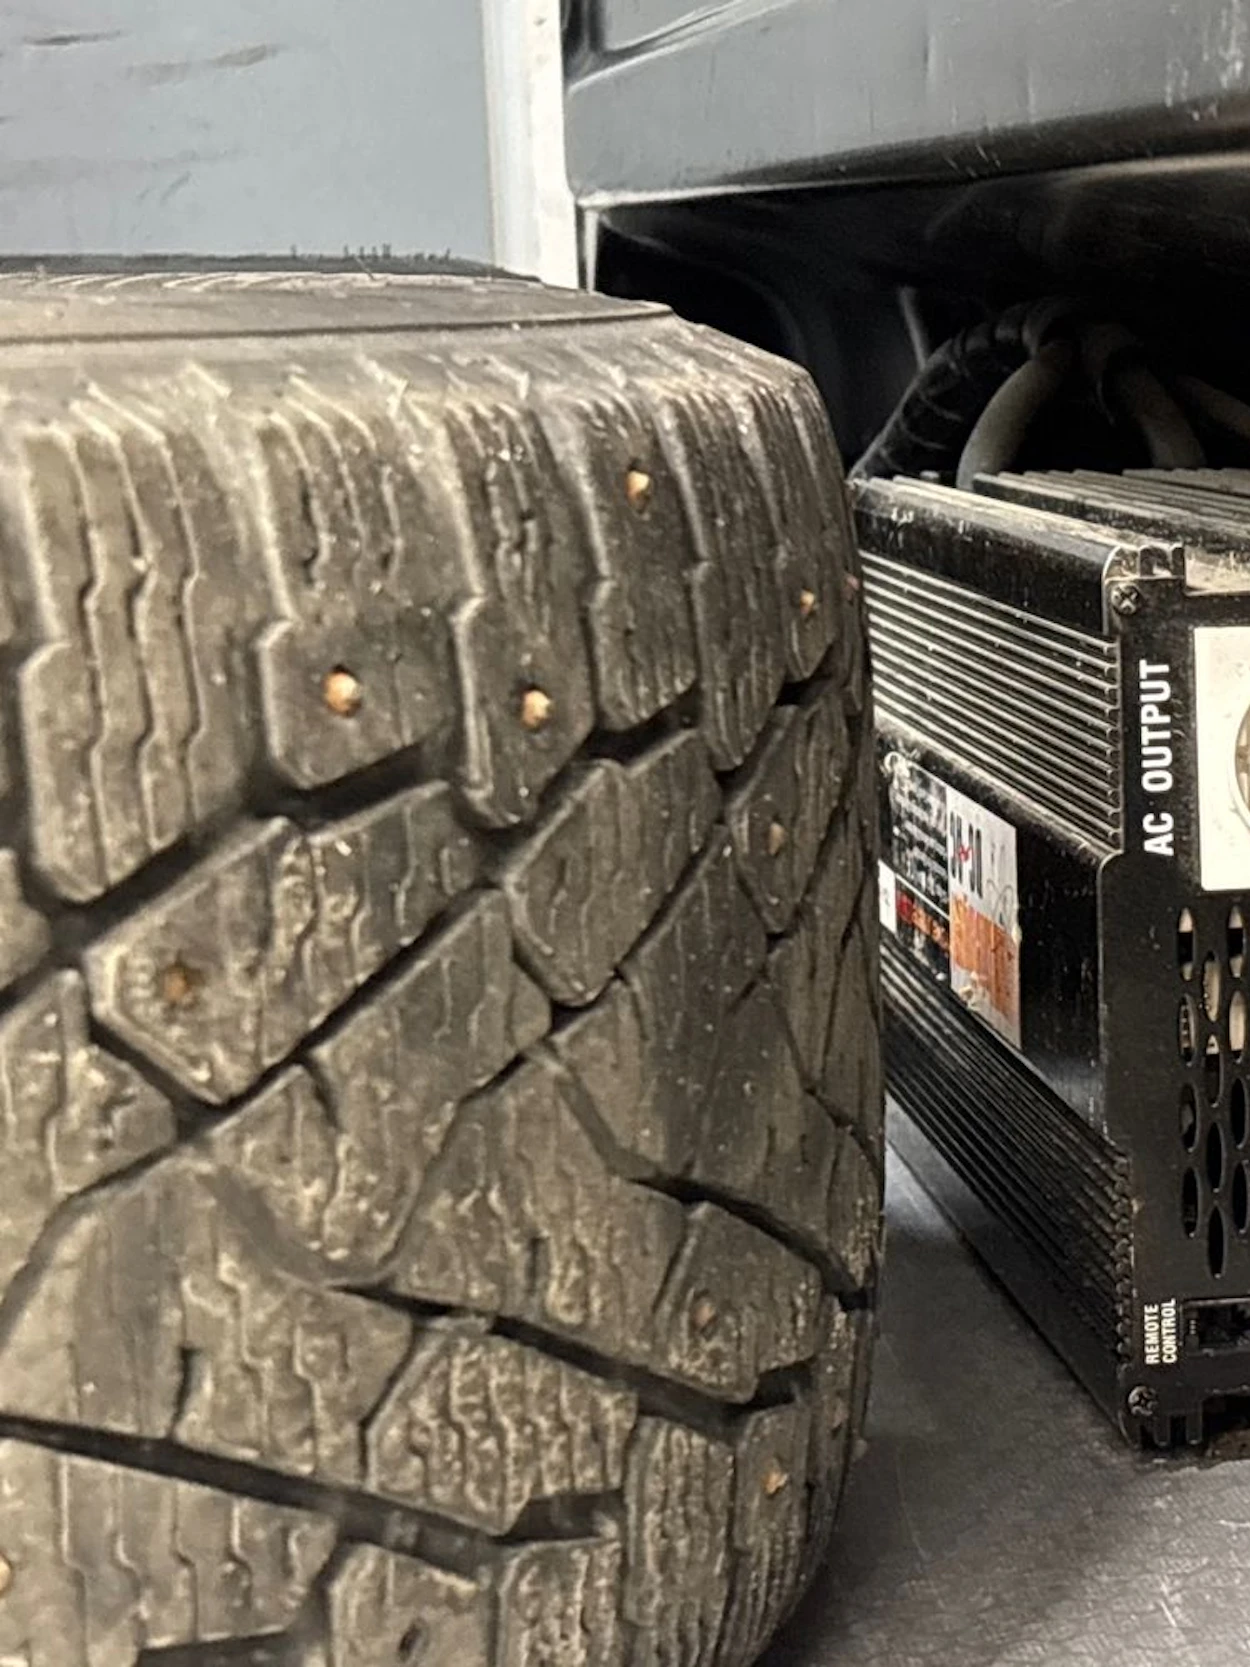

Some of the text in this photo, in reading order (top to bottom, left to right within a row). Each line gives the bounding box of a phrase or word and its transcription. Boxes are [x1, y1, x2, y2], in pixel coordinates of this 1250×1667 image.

[1139, 658, 1175, 857] AC OUTPUT
[1143, 1303, 1160, 1365] REMOTE
[1160, 1297, 1178, 1364] CONTROL
